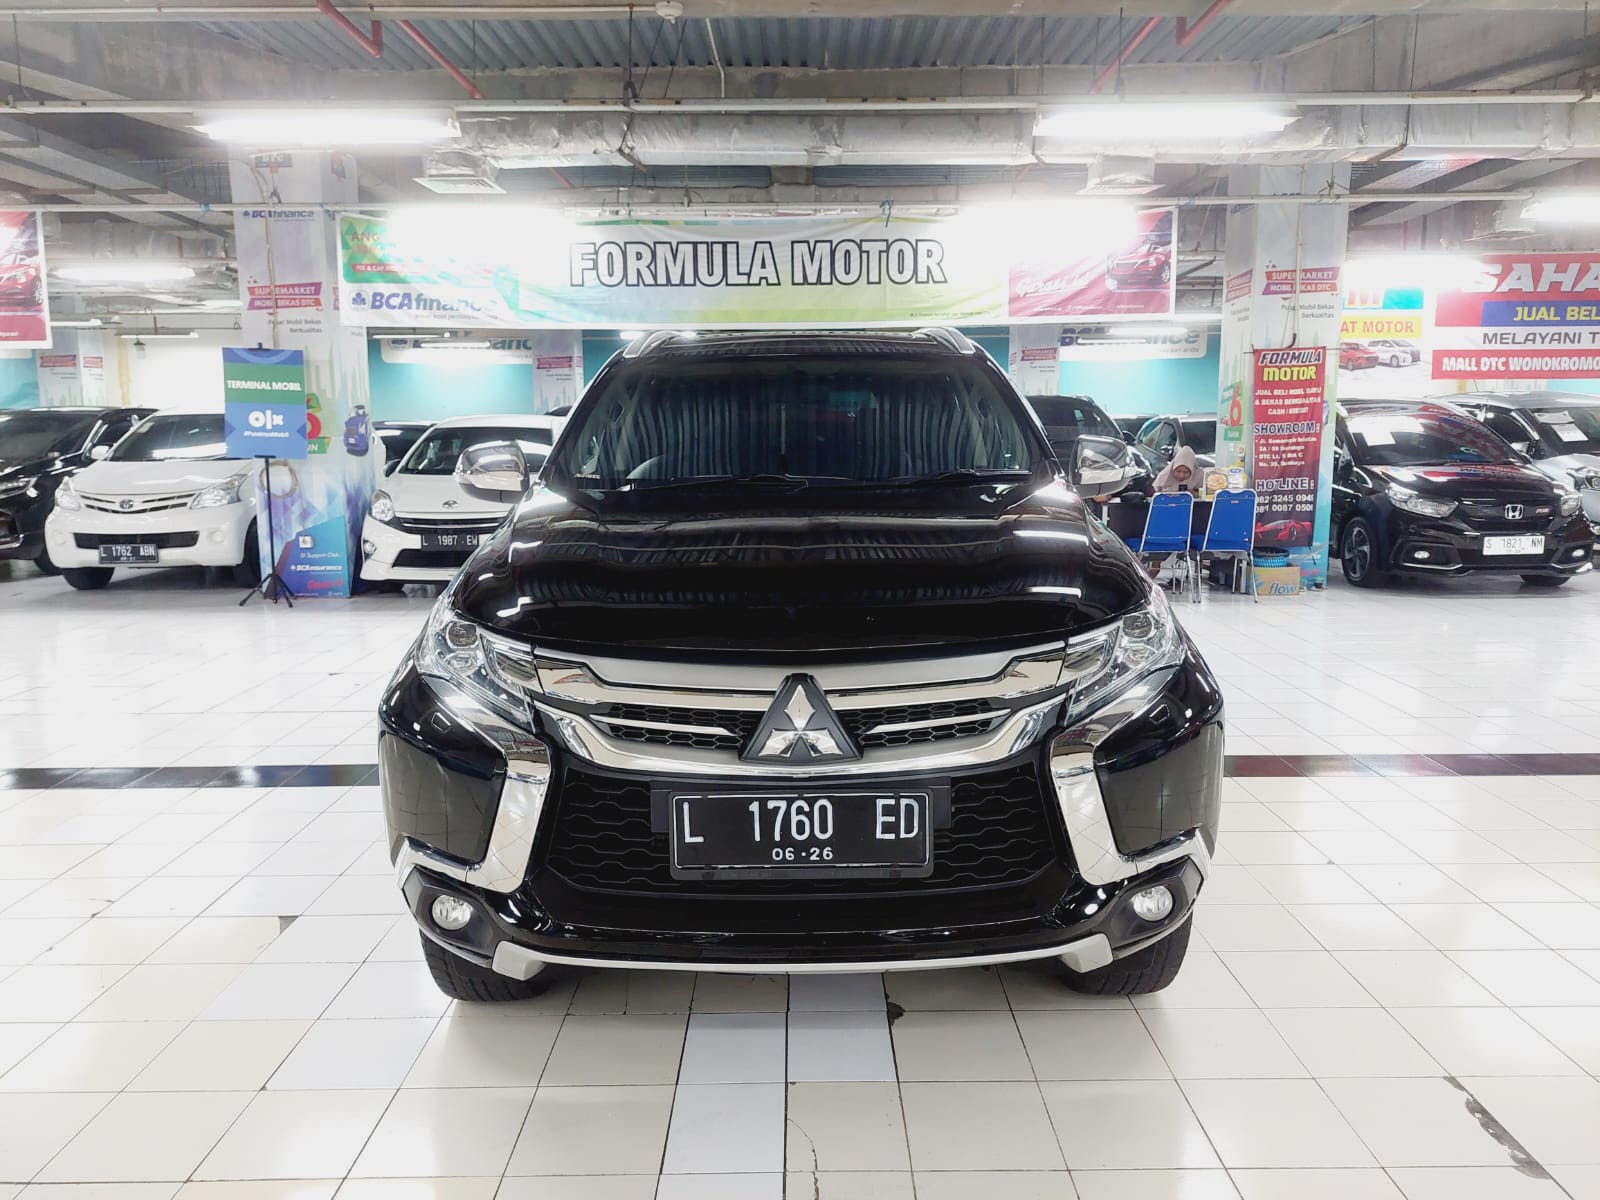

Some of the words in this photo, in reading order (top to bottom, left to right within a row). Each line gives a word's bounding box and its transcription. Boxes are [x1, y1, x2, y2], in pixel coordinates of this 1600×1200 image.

[570, 240, 781, 287] FORMULA
[791, 239, 948, 285] MOTOR
[1513, 307, 1561, 321] JUAL
[1363, 321, 1414, 333] MOTOR
[1482, 332, 1582, 345] MELAYANI
[1259, 349, 1322, 366] FORMULA
[1442, 357, 1477, 371] MALL
[1480, 357, 1506, 371] DTC
[1263, 366, 1317, 382] MOTOR
[227, 380, 271, 390] TERMINAL
[272, 381, 302, 391] MOBIL
[1254, 422, 1315, 435] SHOWROOM
[1256, 478, 1309, 491] HOTLINE
[422, 535, 428, 546] L
[437, 535, 458, 546] 1987
[466, 535, 478, 546] EW
[100, 547, 107, 557] L
[111, 545, 132, 557] 1762
[683, 801, 704, 843] L
[749, 799, 833, 842] 1760
[876, 798, 919, 840] ED
